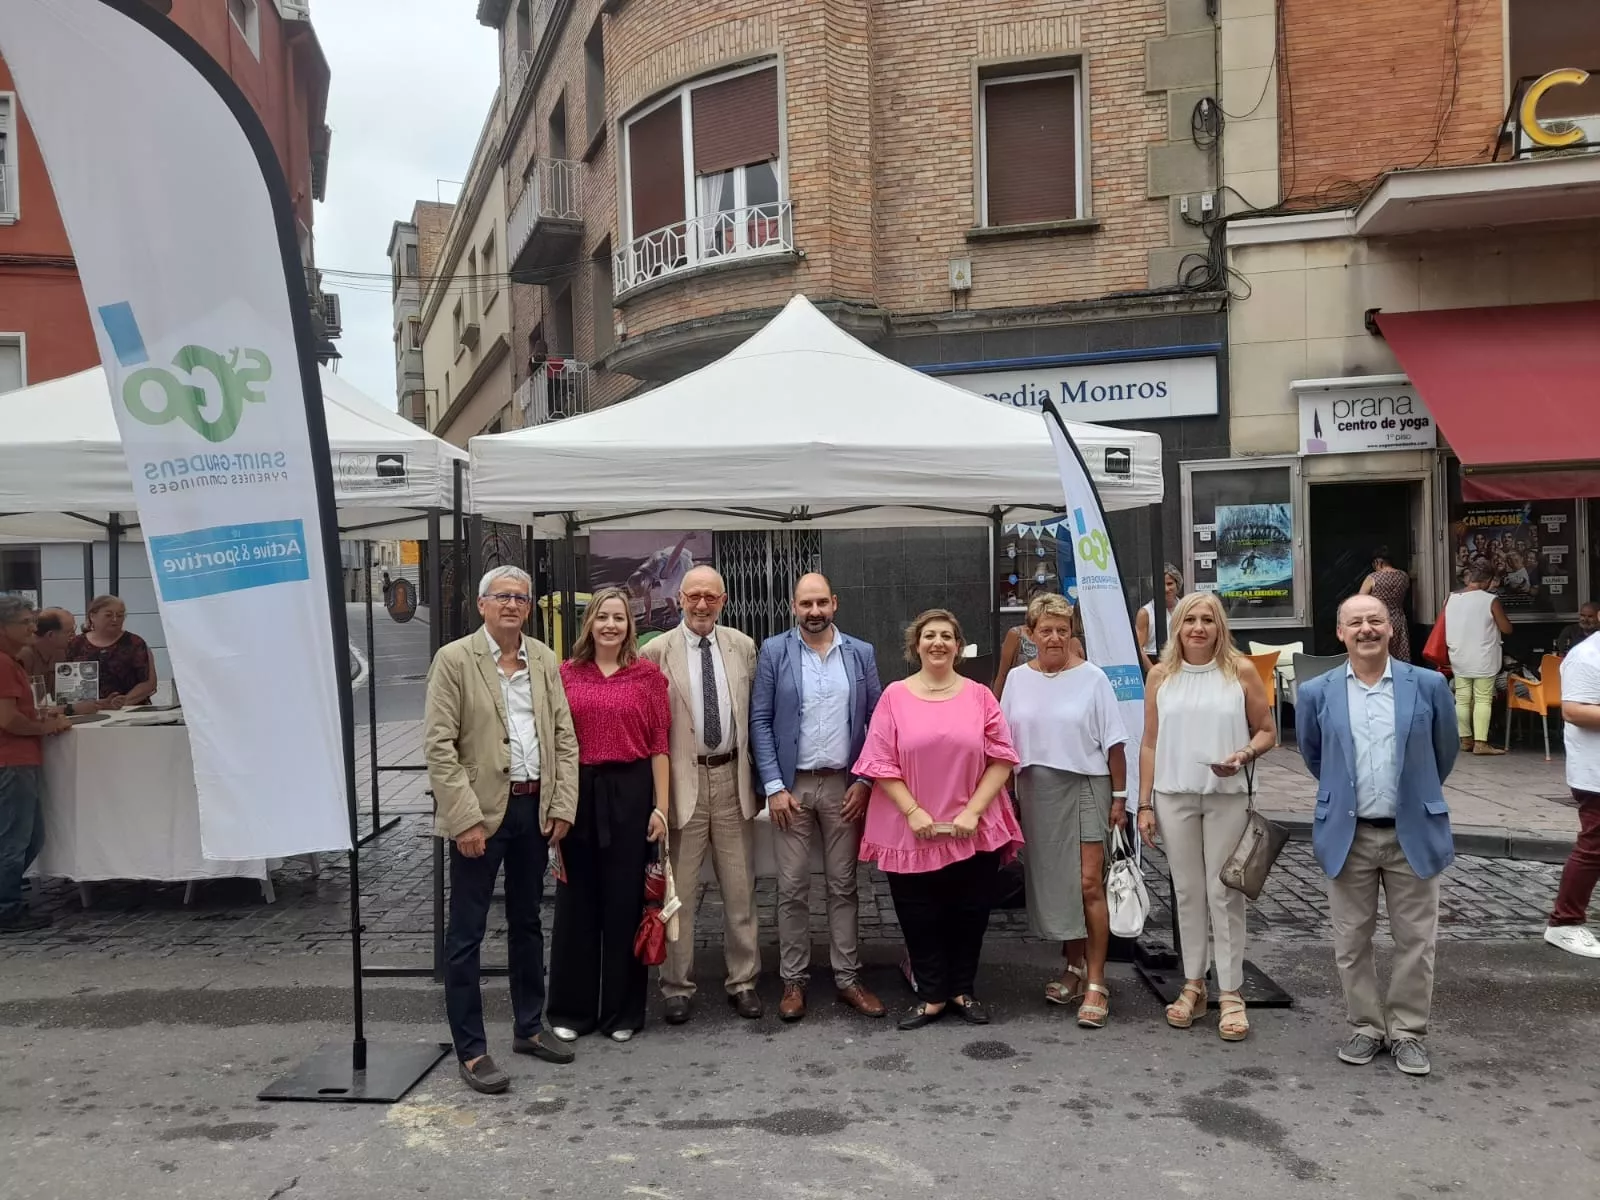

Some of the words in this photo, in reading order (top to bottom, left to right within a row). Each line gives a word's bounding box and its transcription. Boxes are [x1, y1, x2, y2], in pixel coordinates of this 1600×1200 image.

[1060, 379, 1168, 405] Monros
[1332, 395, 1414, 424] prana
[1338, 419, 1377, 432] centro
[1381, 417, 1396, 429] de
[1400, 417, 1430, 432] yoga
